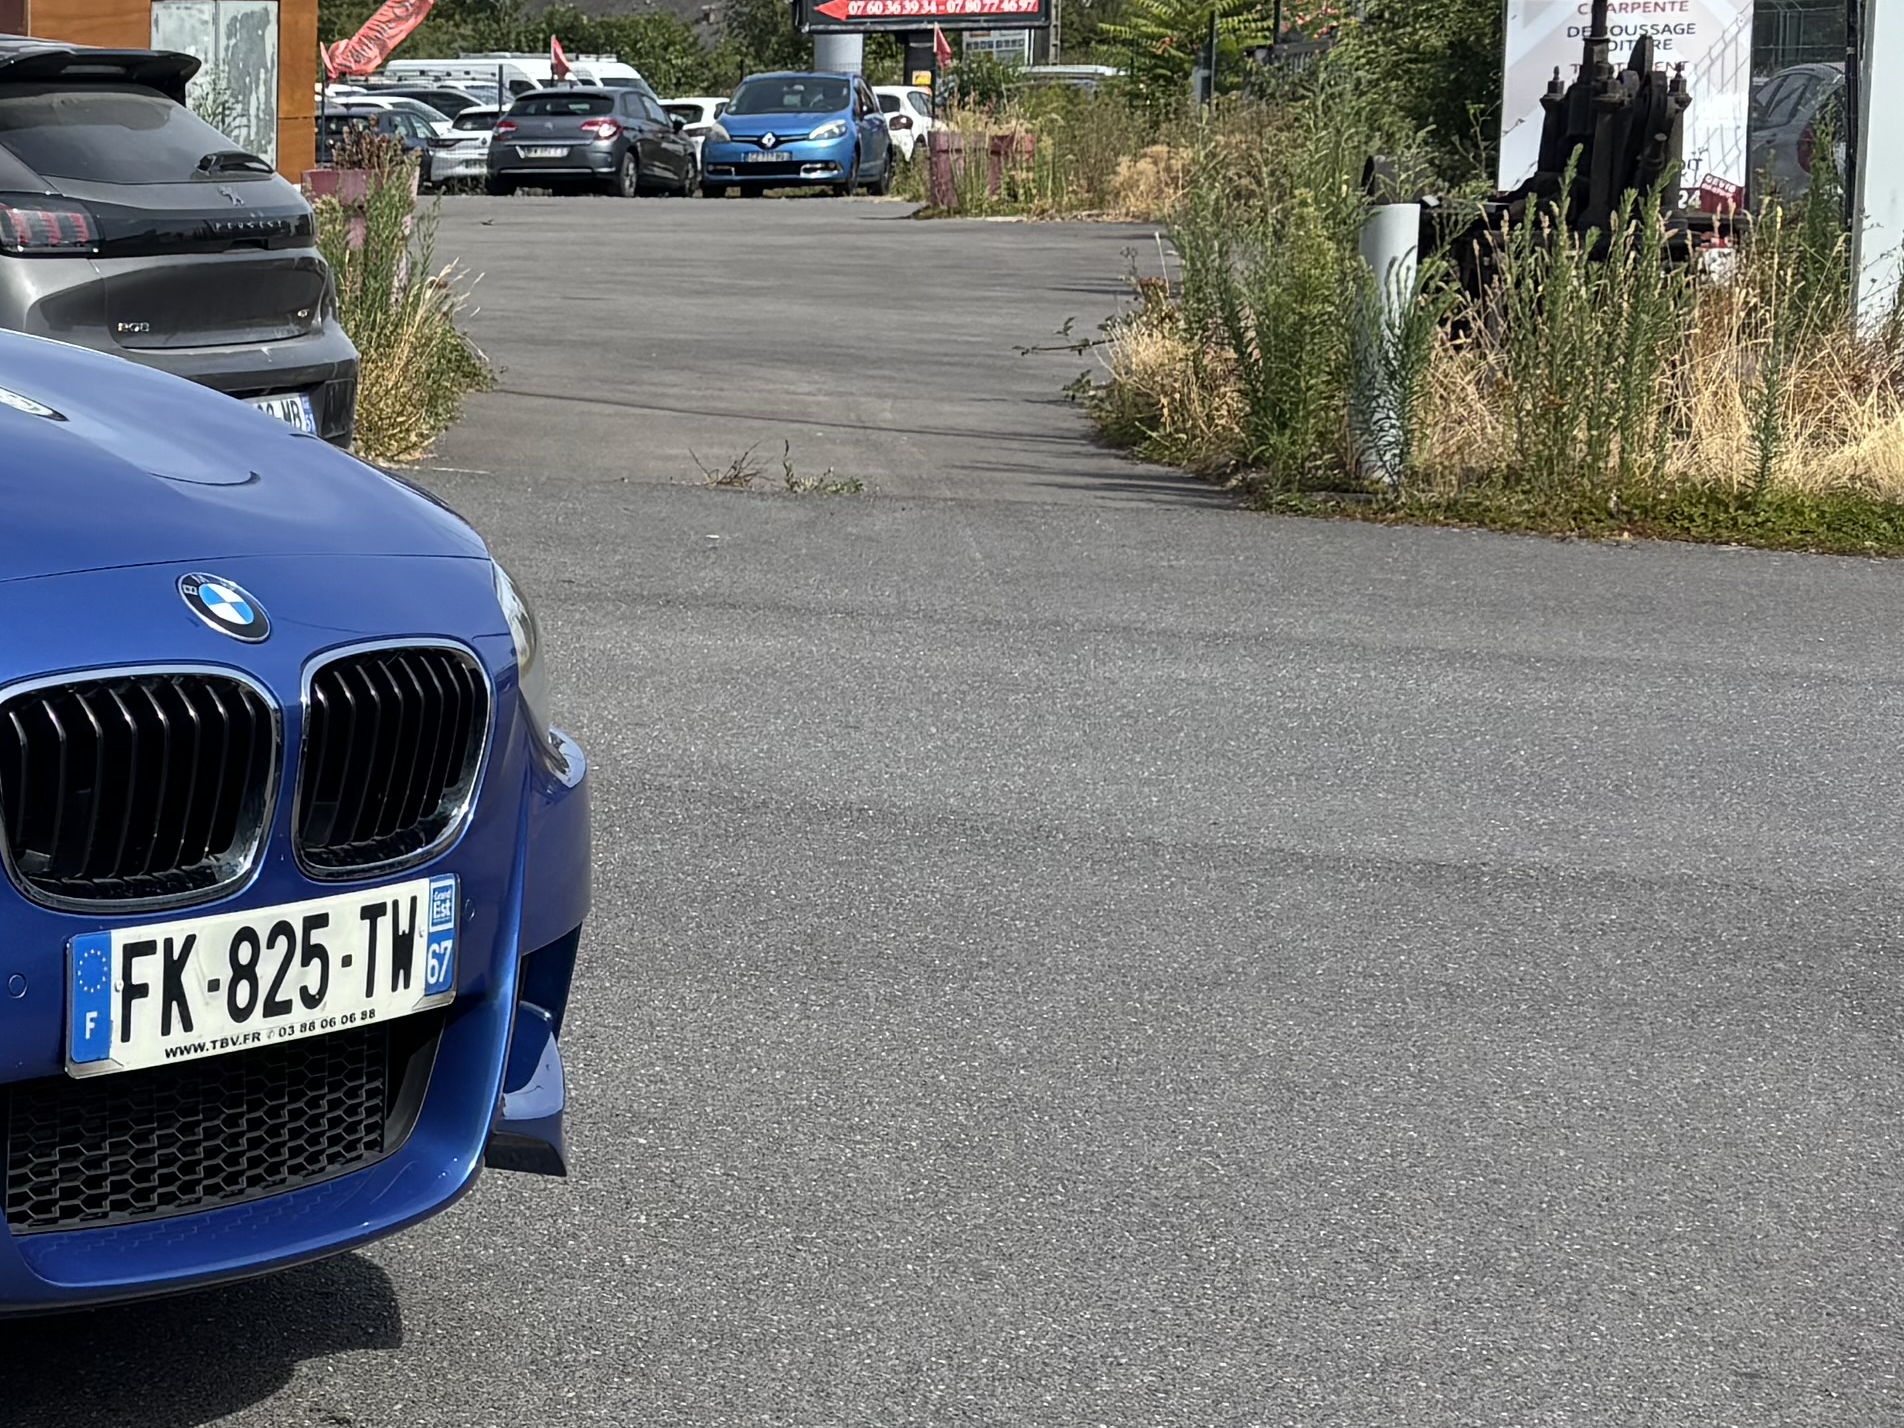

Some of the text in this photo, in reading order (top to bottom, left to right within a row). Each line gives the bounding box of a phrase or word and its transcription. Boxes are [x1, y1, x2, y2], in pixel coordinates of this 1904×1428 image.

[848, 3, 866, 15] 07
[867, 2, 883, 15] 60
[885, 2, 901, 14] 36
[904, 1, 919, 14] 39
[947, 0, 963, 12] 07
[982, 0, 998, 12] 77
[1577, 0, 1689, 15] CARPENTE
[1567, 23, 1696, 38] DEOUSSAGE
[433, 899, 451, 919] Est
[119, 894, 421, 1044] FK-825-TW
[427, 939, 453, 985] 67
[84, 1011, 98, 1040] F
[164, 1031, 261, 1059] WWW.TBV.FR
[278, 1025, 295, 1038] 03
